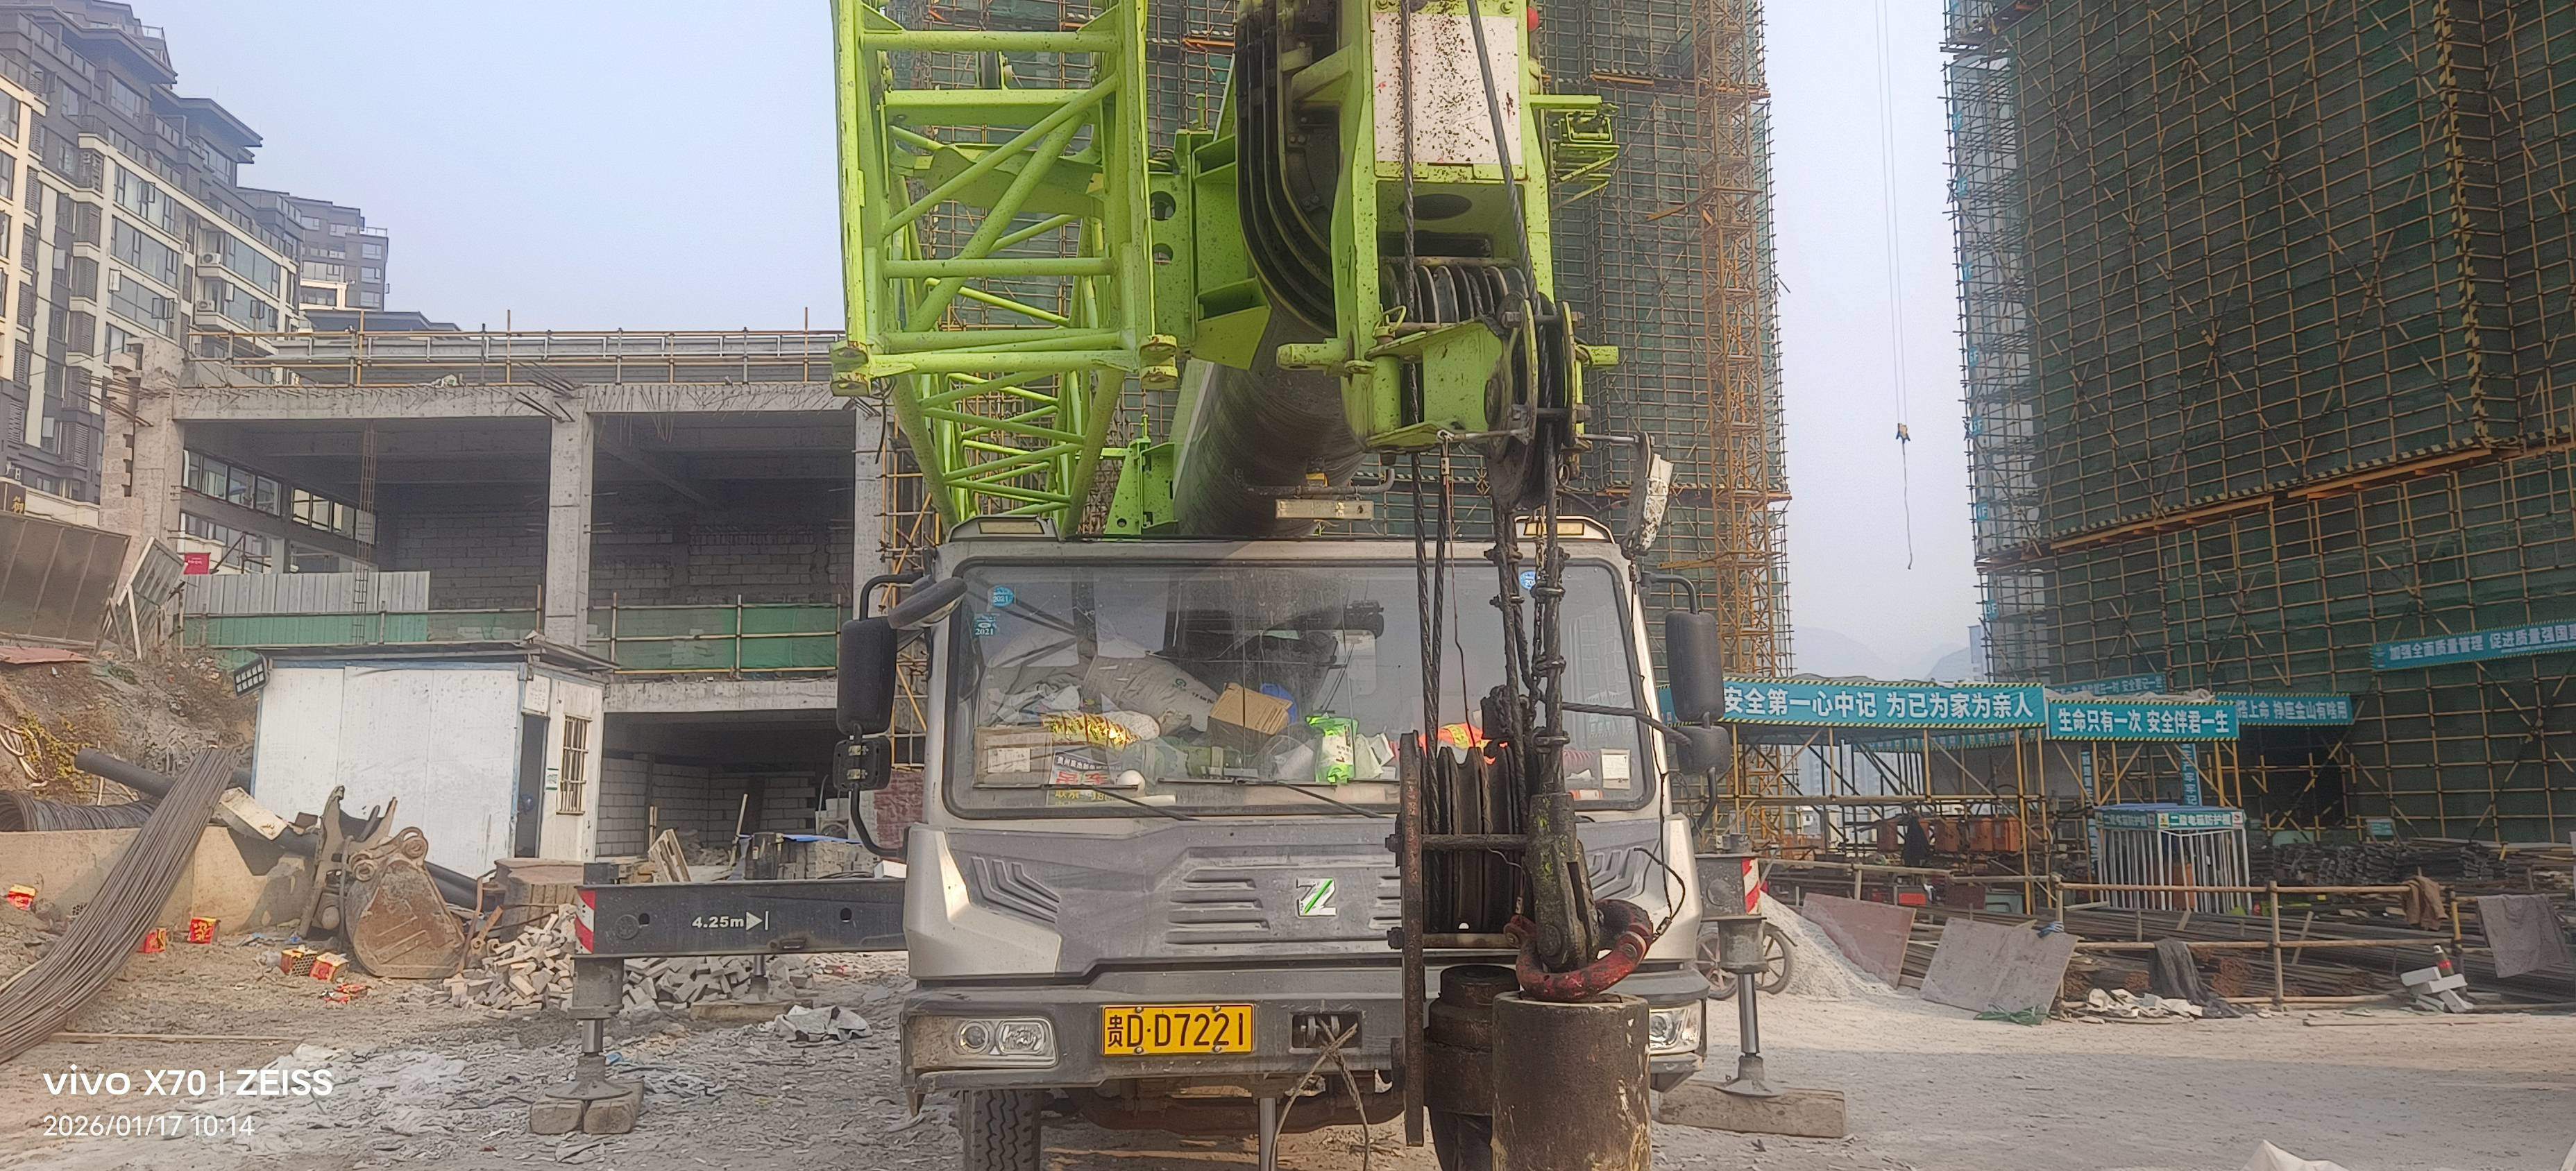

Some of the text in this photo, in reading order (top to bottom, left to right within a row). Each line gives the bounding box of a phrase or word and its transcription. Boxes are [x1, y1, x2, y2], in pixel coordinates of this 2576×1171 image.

[2389, 635, 2484, 660] 加强全面质量管理
[1724, 686, 1877, 718] 安全第一心中记
[2058, 708, 2230, 734] 生命只有一次 安全伴君一生
[692, 915, 745, 929] 4.25m
